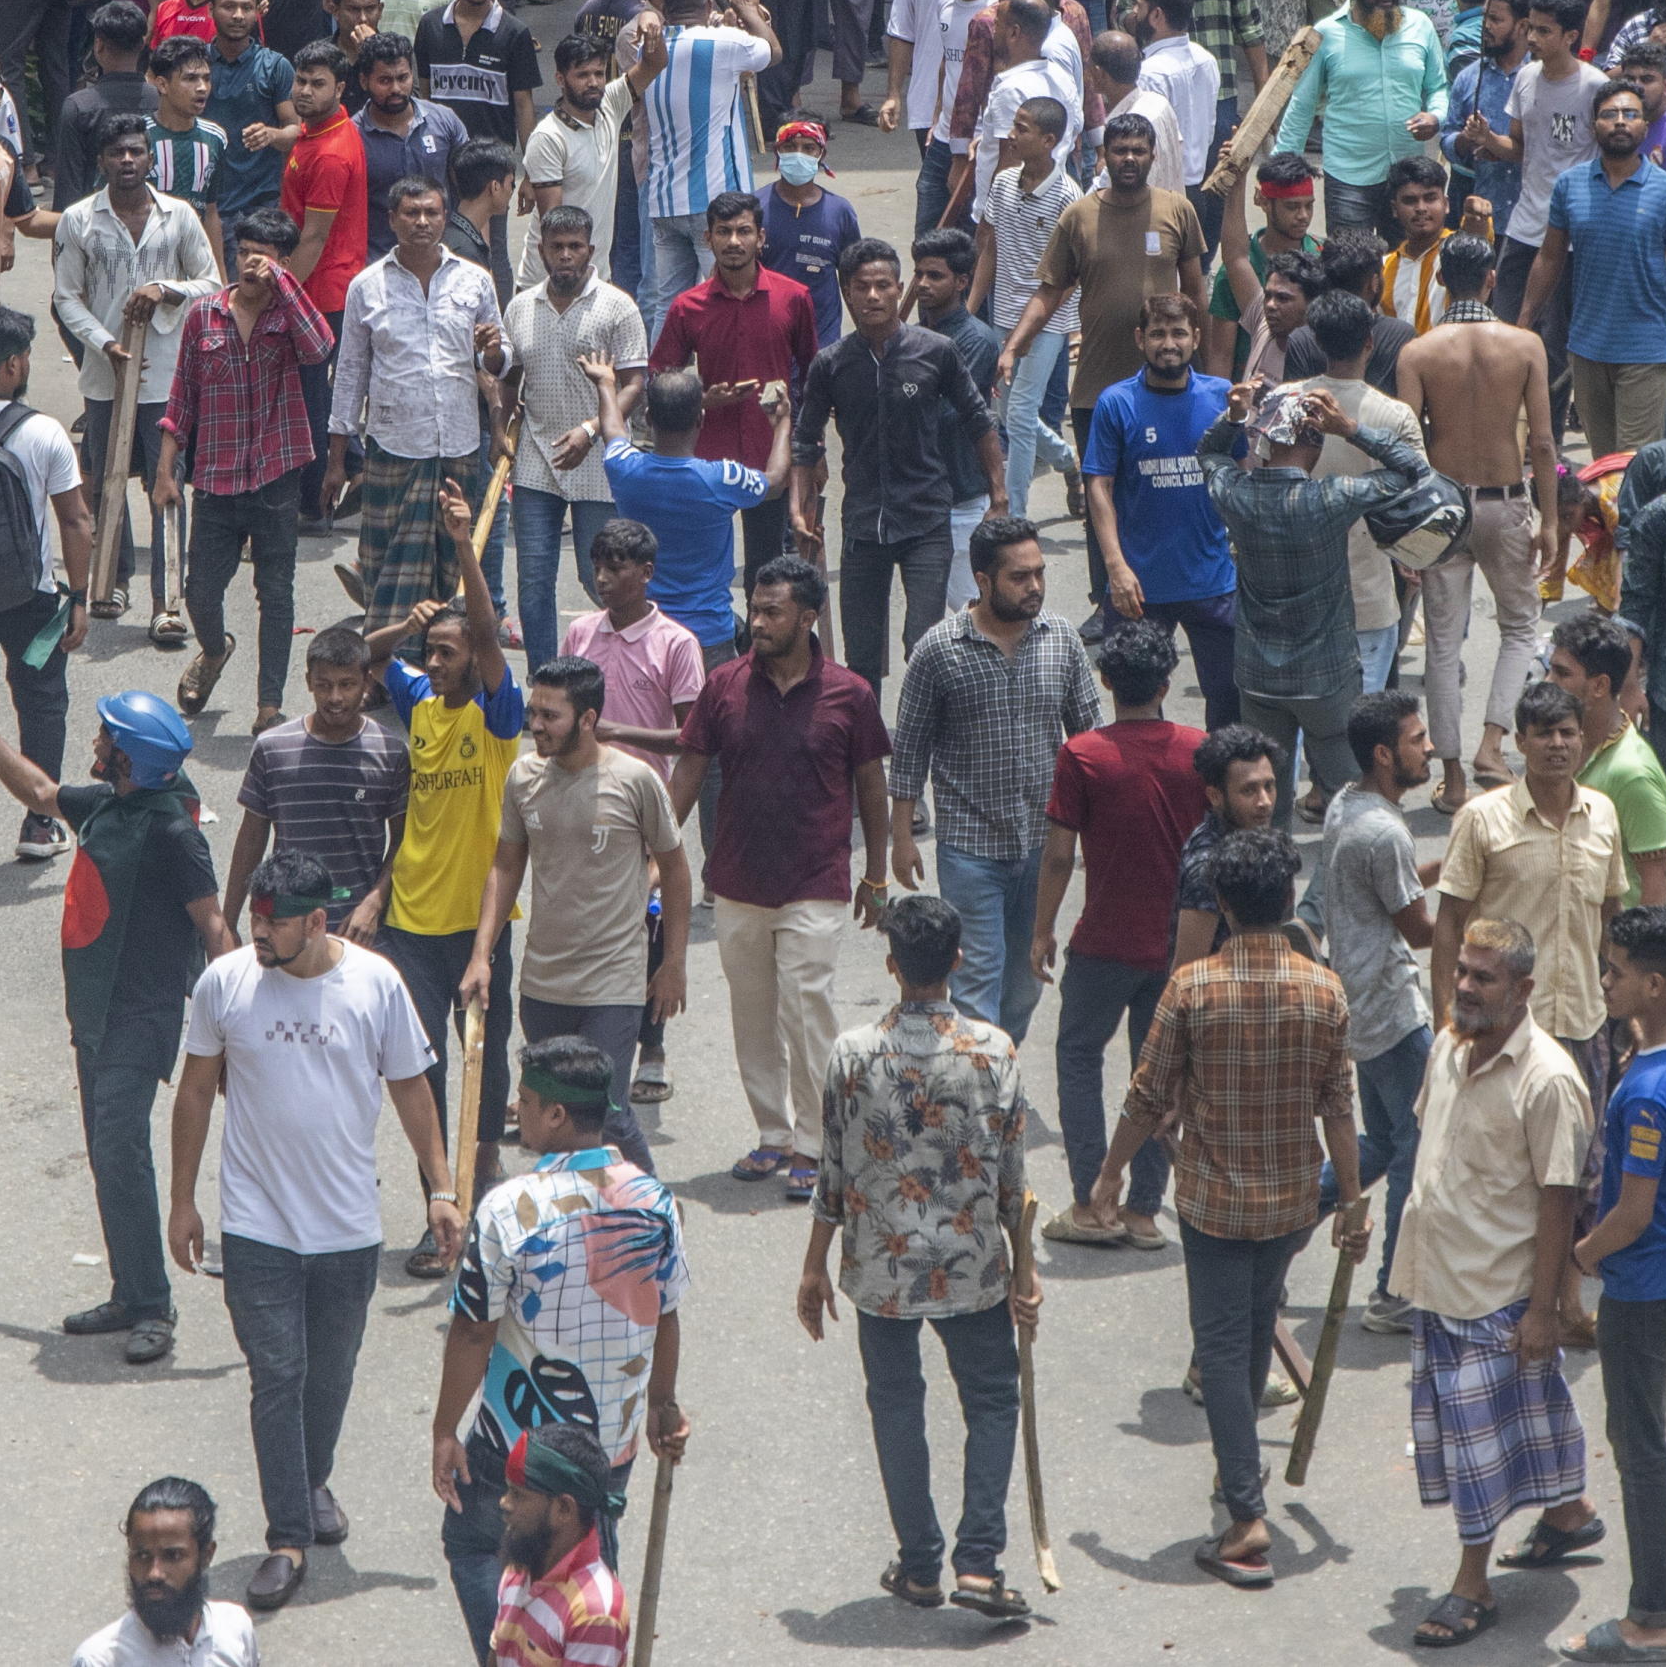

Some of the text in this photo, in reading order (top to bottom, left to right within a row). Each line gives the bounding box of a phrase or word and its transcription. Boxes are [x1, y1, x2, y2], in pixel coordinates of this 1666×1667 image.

[431, 68, 496, 100] Seventy
[422, 135, 437, 154] 9
[1145, 427, 1157, 443] 5
[1152, 474, 1182, 488] COUNCIL
